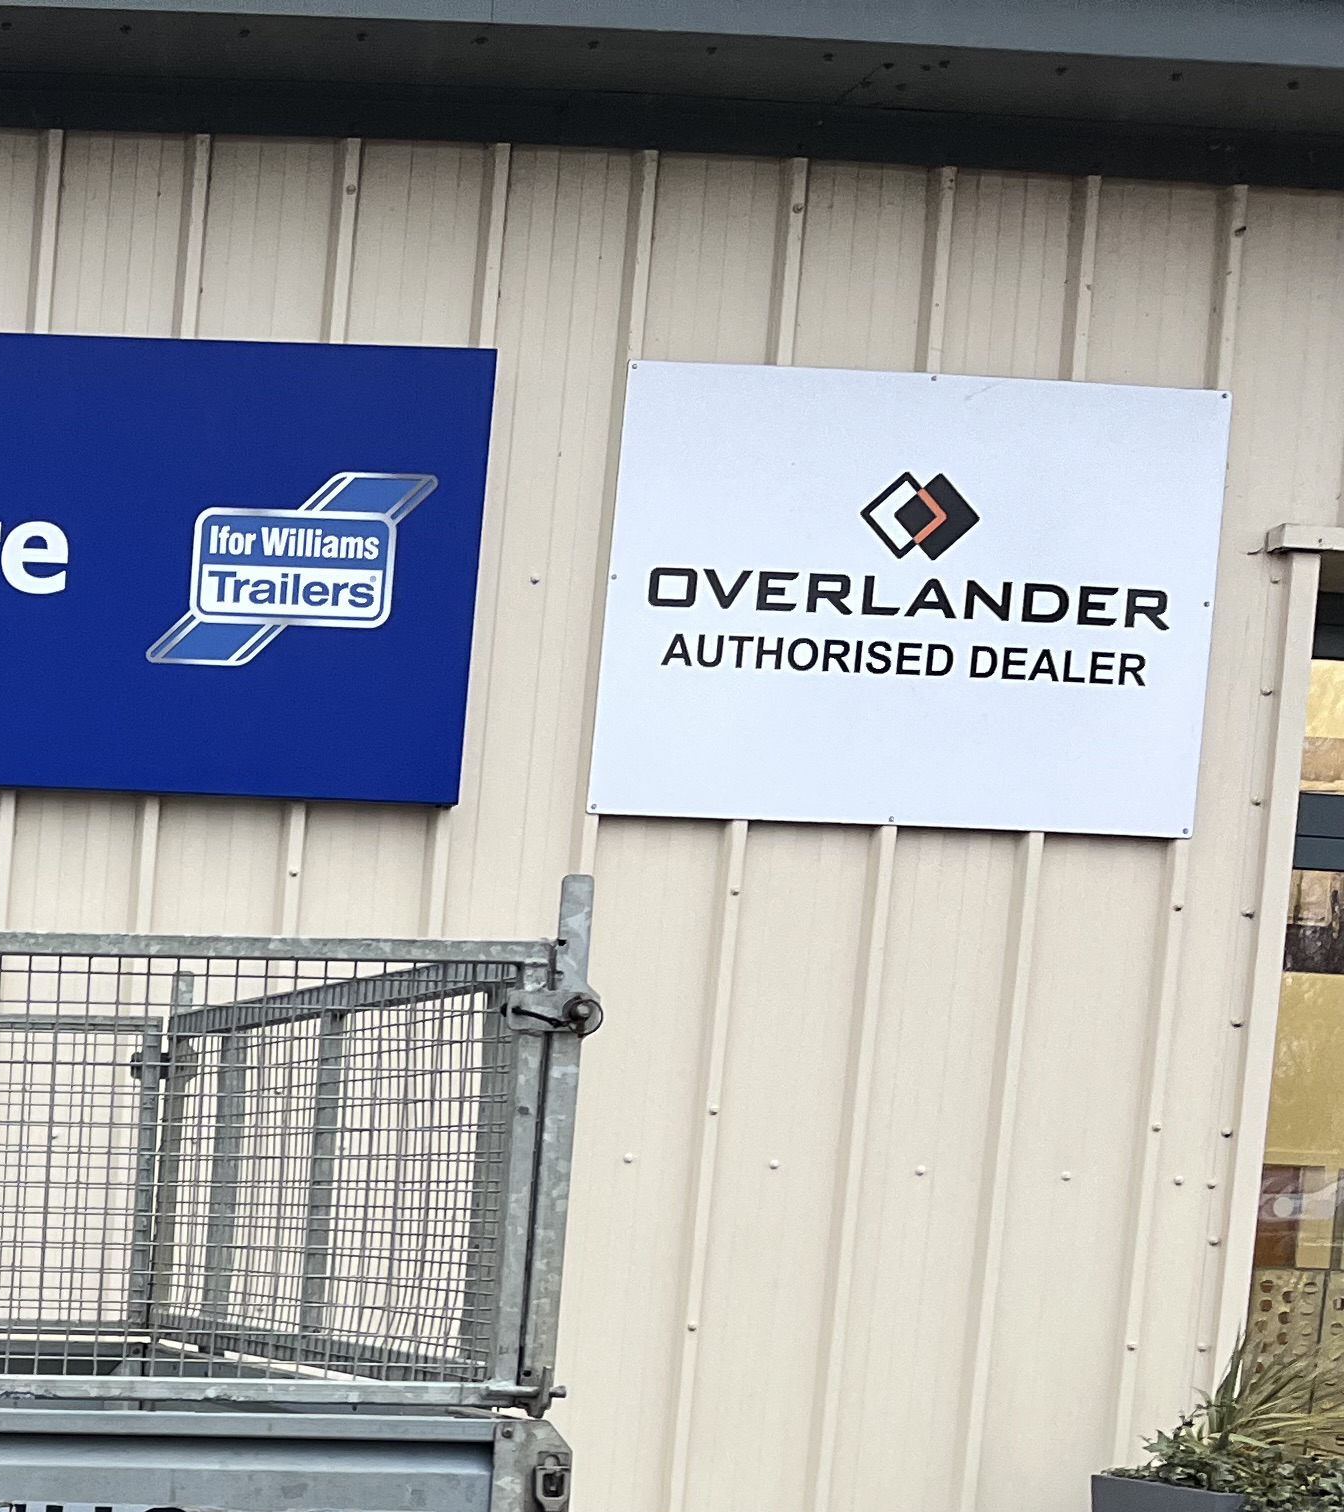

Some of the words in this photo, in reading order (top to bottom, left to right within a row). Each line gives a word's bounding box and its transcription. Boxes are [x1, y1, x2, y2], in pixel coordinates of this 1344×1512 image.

[209, 525, 257, 556] Ifor
[261, 526, 380, 560] Williams
[207, 570, 375, 608] Trailers
[648, 566, 1170, 631] OVERLANDER
[661, 633, 954, 677] AUTHORISED
[969, 645, 1146, 687] DEALER
